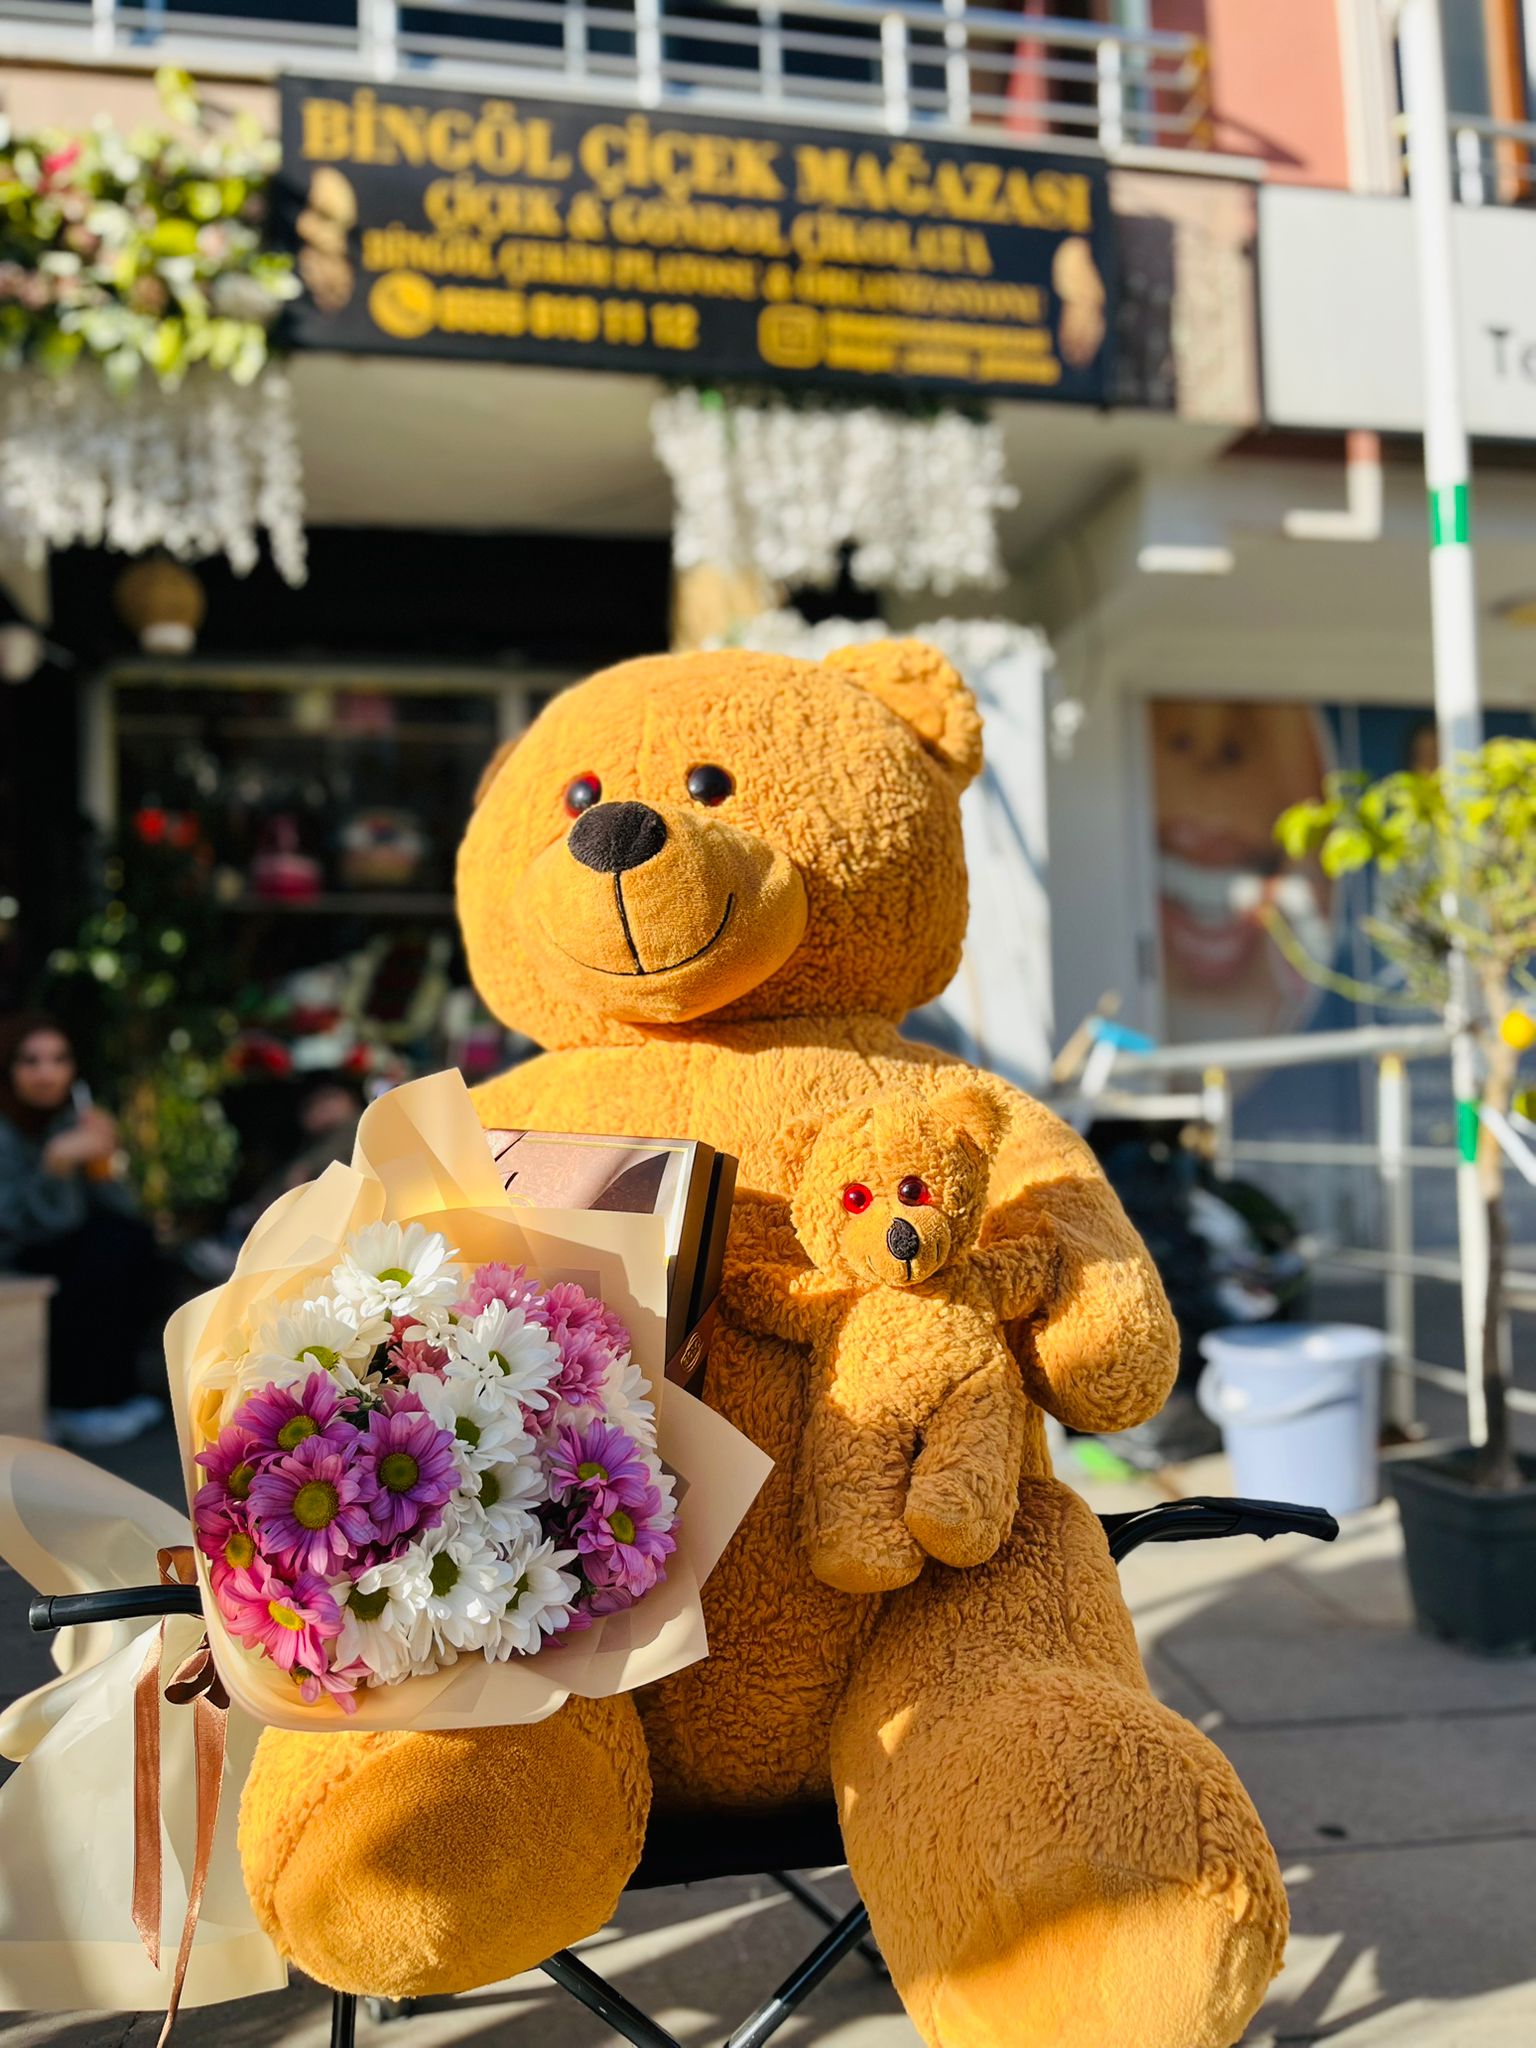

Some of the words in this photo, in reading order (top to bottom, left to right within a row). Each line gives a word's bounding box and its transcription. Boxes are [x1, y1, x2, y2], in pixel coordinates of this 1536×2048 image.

[303, 89, 571, 180] BİNGÖL
[580, 115, 781, 203] ÇİÇEK
[796, 142, 1091, 232] MAĞAZASI
